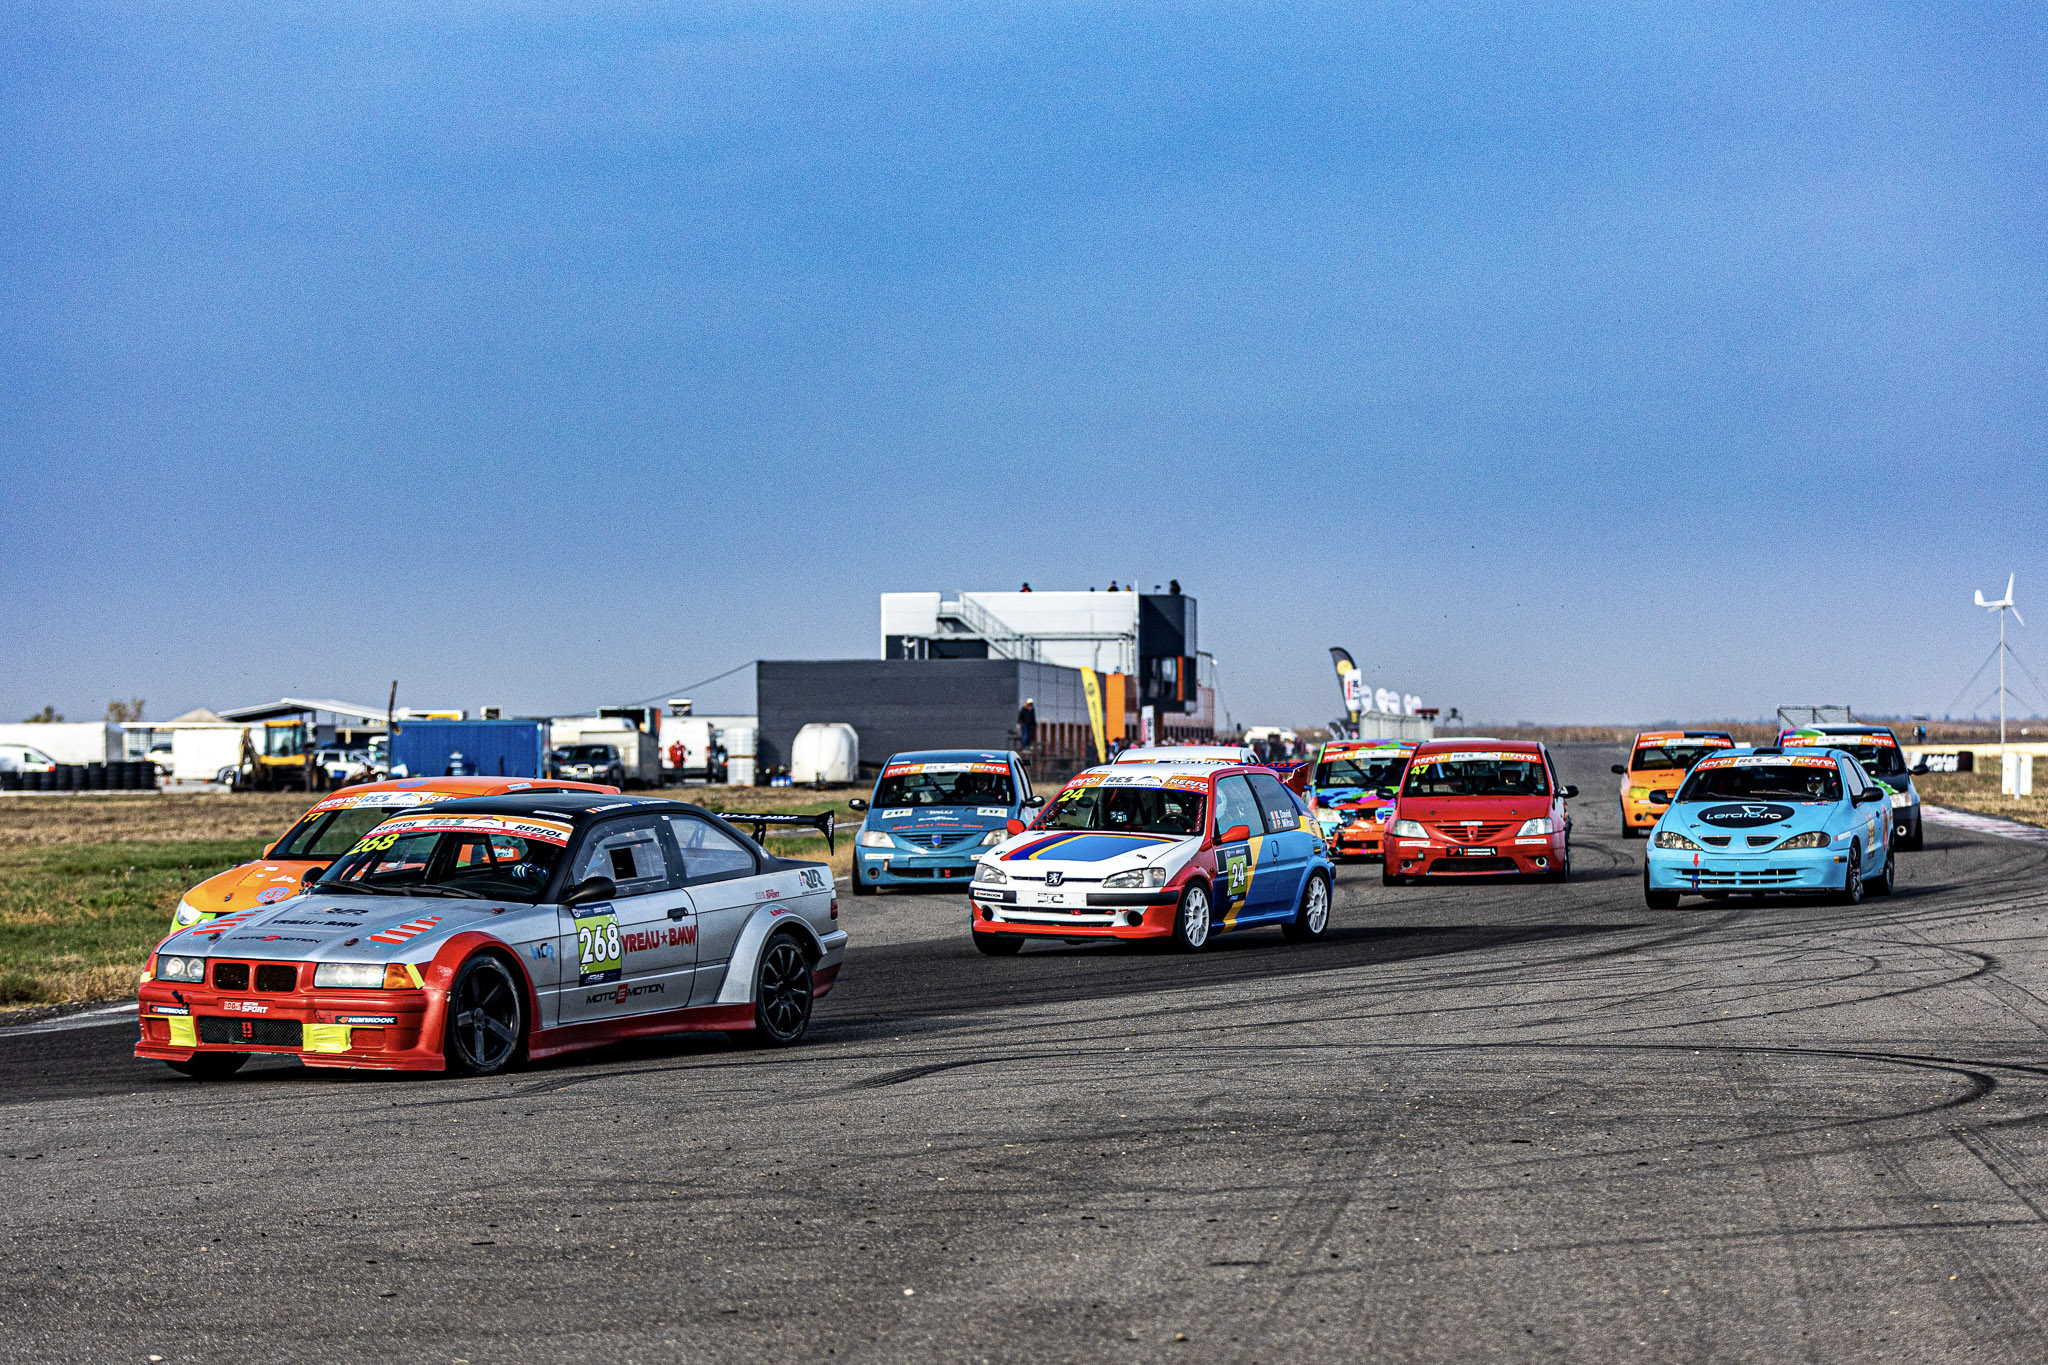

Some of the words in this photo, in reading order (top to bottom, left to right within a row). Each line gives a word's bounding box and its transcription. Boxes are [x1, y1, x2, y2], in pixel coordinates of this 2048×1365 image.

[1413, 755, 1448, 765] REPSOL
[1503, 752, 1538, 760] REPSOL
[1410, 764, 1430, 776] 47
[360, 794, 393, 803] RES
[1057, 788, 1086, 803] 24
[427, 817, 465, 826] RES
[514, 823, 563, 839] REPSOL
[345, 833, 401, 857] 268
[1231, 861, 1246, 888] 24
[579, 923, 621, 964] 268
[621, 928, 660, 957] VREAU
[668, 925, 697, 948] BMW
[241, 1005, 269, 1013] SPORT
